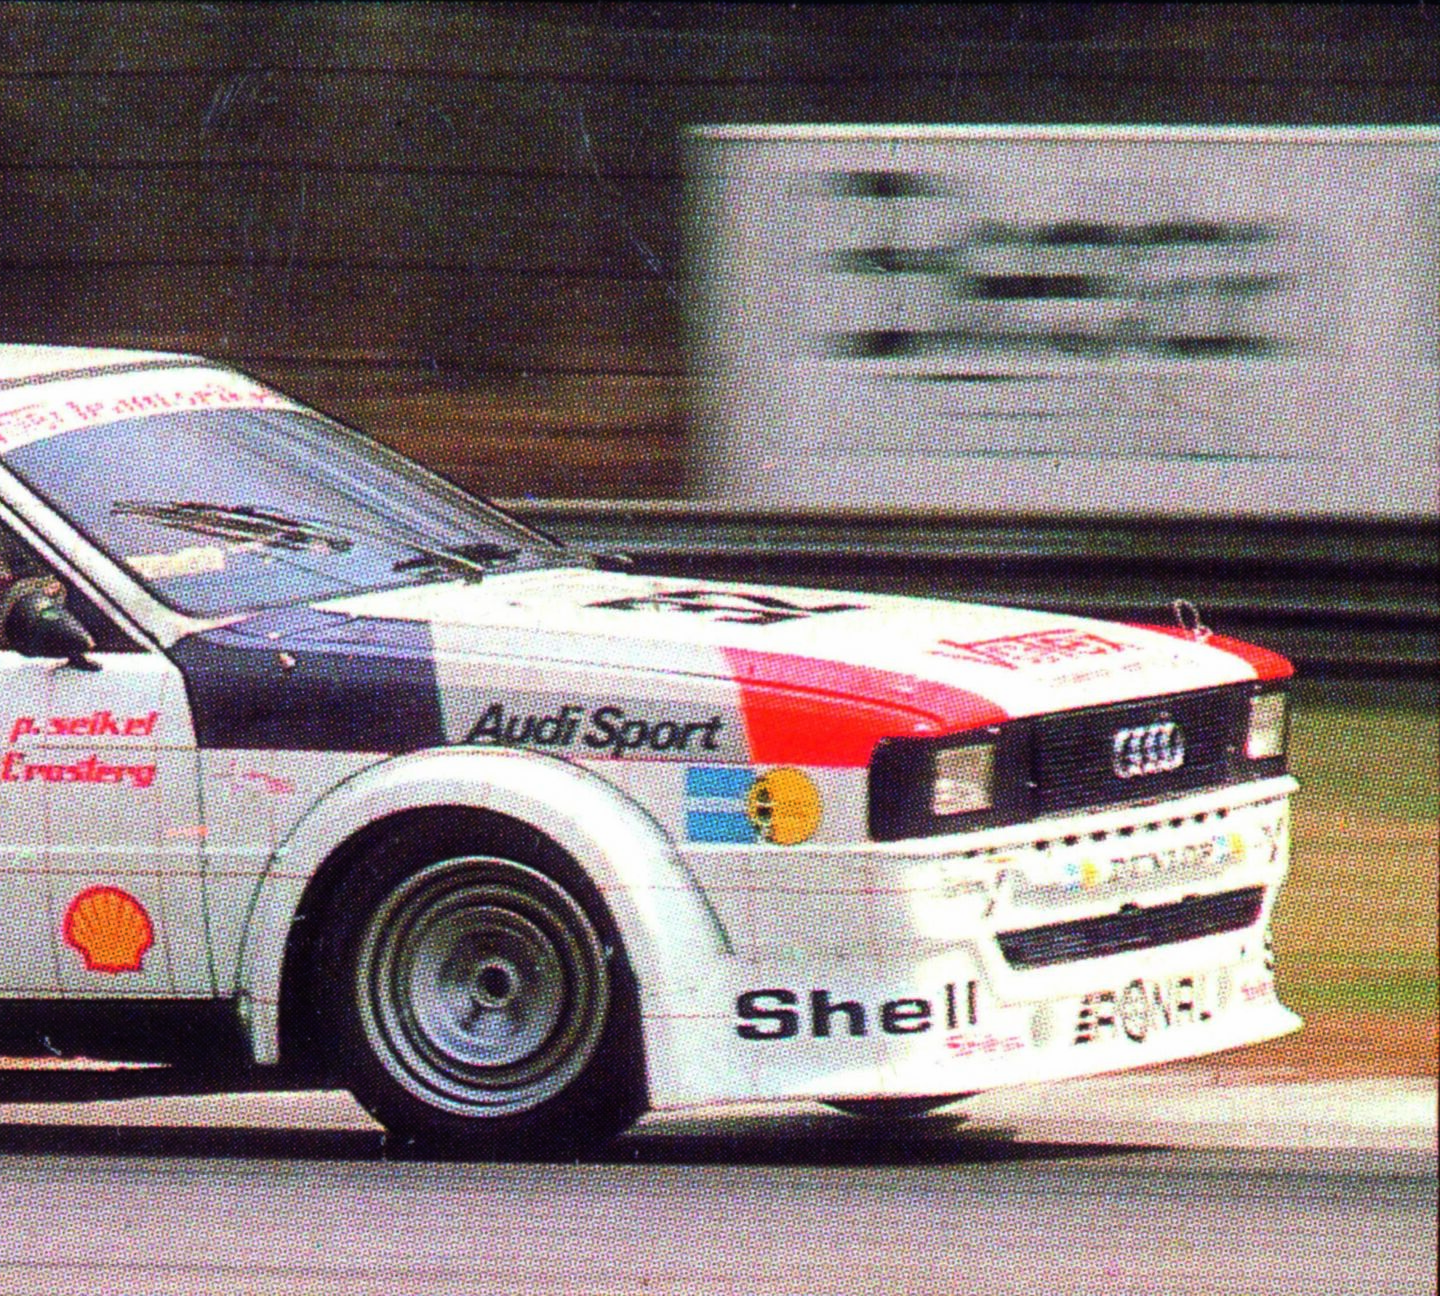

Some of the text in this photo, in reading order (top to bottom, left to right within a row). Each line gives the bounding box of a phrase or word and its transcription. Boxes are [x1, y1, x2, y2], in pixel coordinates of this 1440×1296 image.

[465, 702, 724, 757] Audi Sport
[736, 980, 978, 1041] Shell
